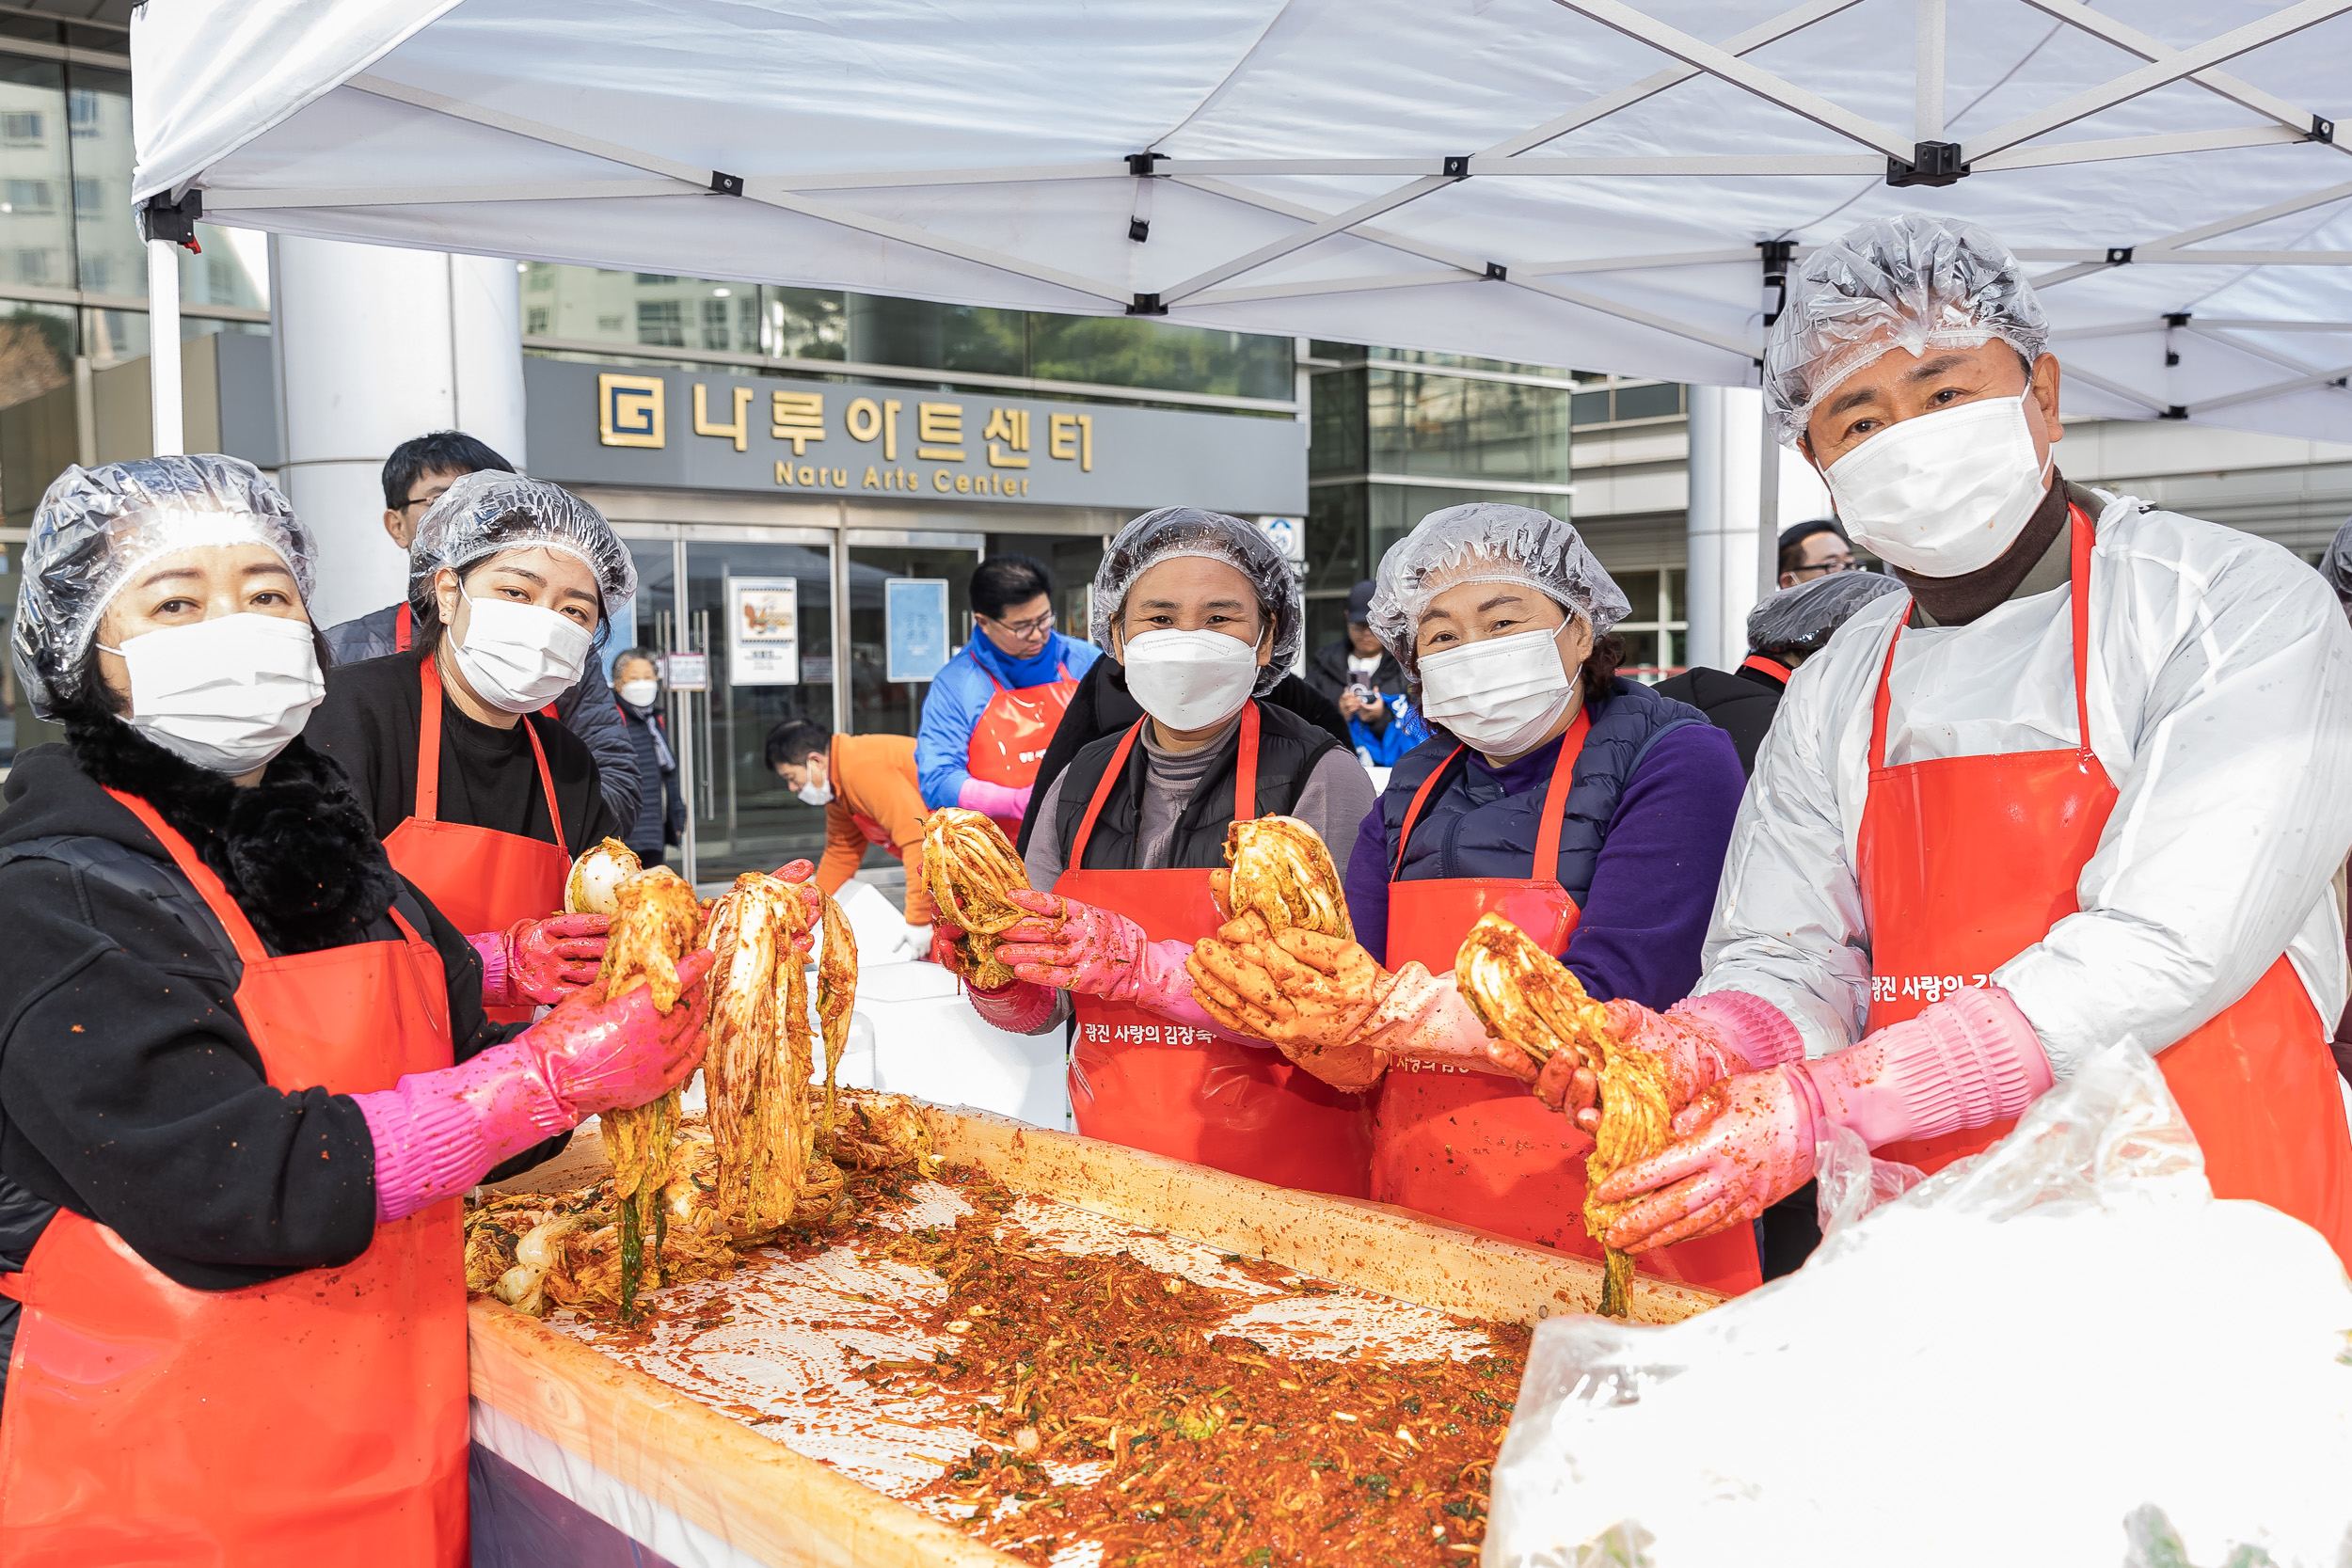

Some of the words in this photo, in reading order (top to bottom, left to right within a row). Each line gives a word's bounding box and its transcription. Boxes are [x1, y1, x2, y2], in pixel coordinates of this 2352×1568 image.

[691, 382, 1094, 473] 나루아트센터
[774, 459, 848, 489] Naru
[861, 465, 920, 492] Arts
[932, 467, 1030, 498] Center
[1871, 974, 1897, 1003] 광진
[1901, 974, 1964, 1003] 사랑의
[1084, 1022, 1110, 1044] 광진
[1113, 1023, 1161, 1046] 사랑의
[1164, 1025, 1218, 1046] 김장축
